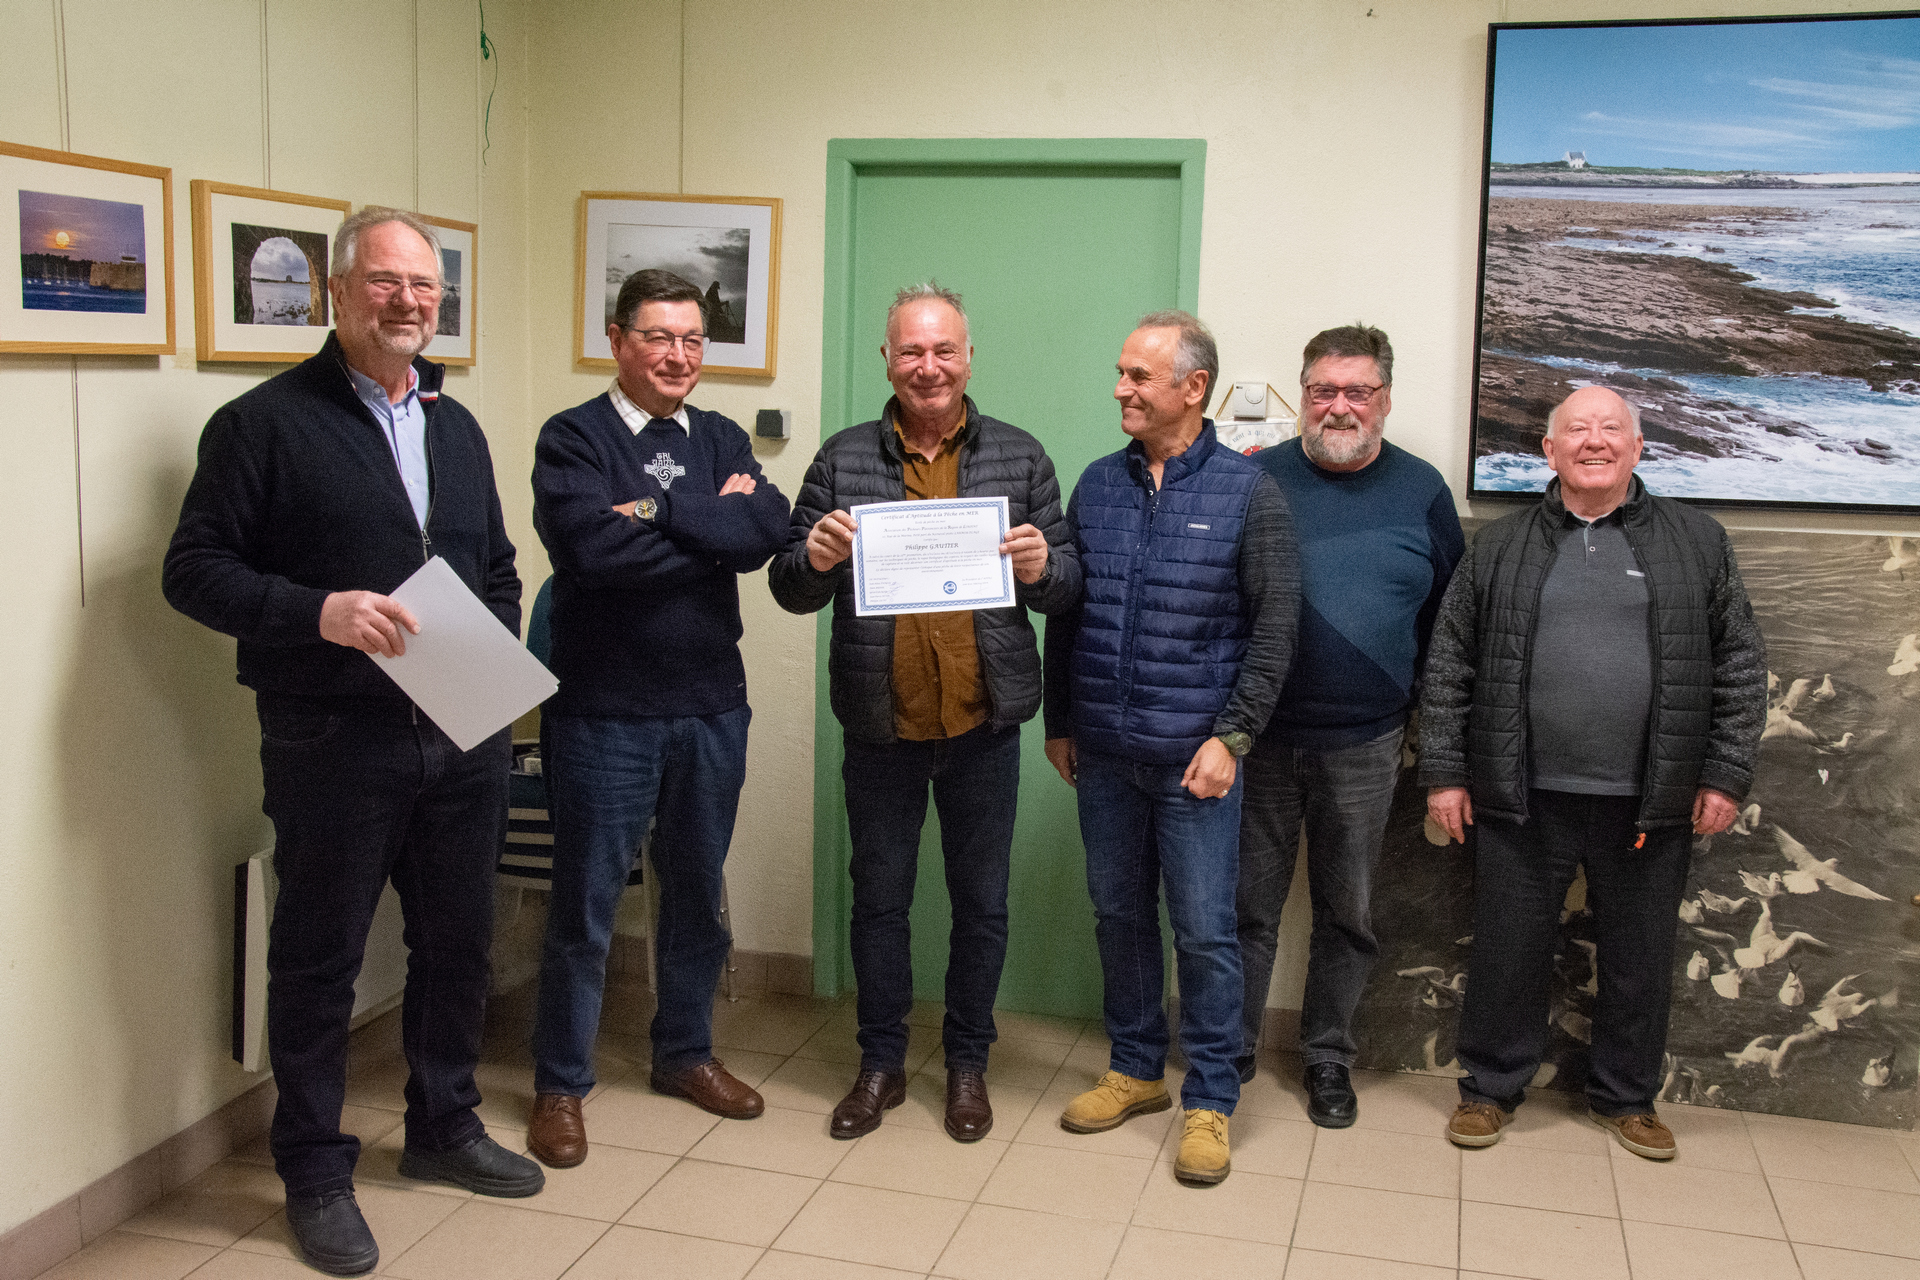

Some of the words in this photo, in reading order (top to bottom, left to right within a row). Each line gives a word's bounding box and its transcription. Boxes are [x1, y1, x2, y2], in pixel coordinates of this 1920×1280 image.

[656, 452, 672, 460] TRI
[905, 512, 932, 520] d'Aptitude
[905, 543, 928, 552] Philippe
[929, 542, 959, 550] GAUTIER
